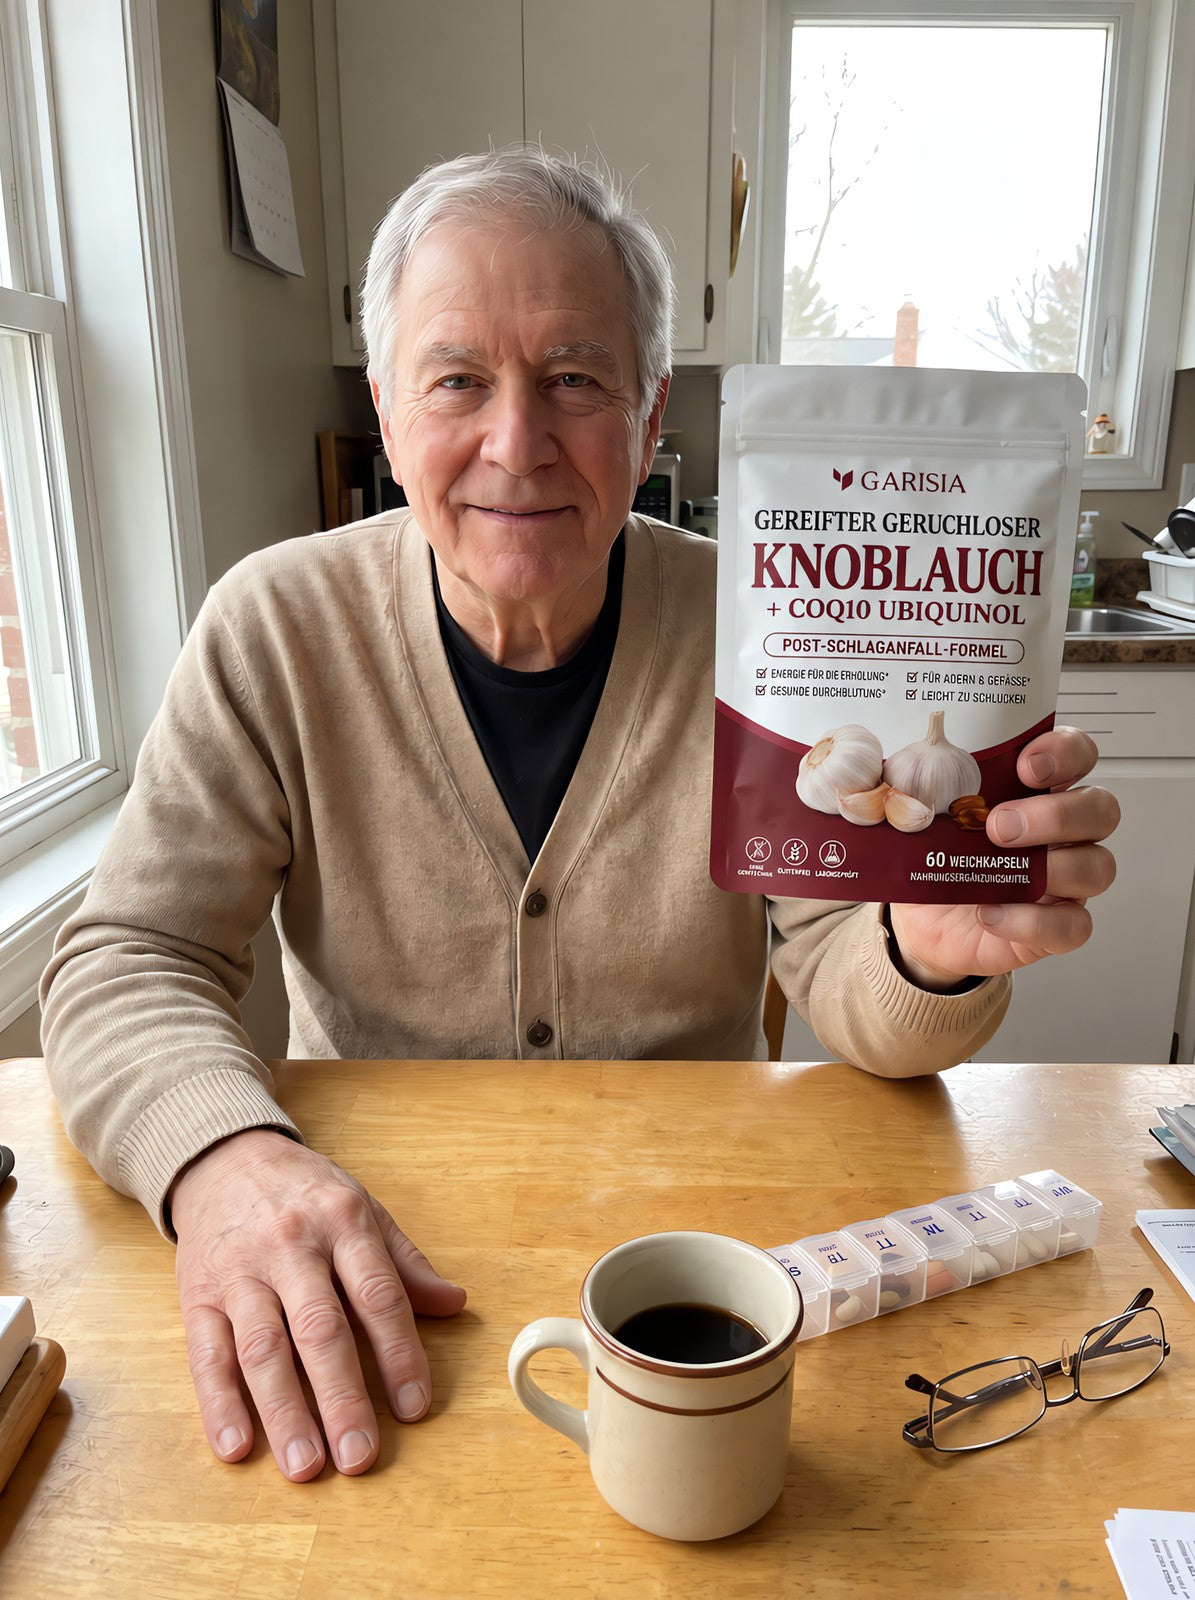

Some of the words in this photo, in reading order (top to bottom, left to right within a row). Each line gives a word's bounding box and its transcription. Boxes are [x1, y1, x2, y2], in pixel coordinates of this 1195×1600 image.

[861, 471, 966, 493] GARISIA
[754, 509, 877, 532] GEREIFTER
[882, 512, 1041, 538] GERUCHLOSER
[751, 543, 1044, 596] KNOBLAUCH
[767, 602, 781, 617] +
[788, 598, 871, 623] COQ10
[879, 600, 1026, 626] UBIQUINOL
[783, 638, 1008, 658] POST-SCHLAGANFALL-FORMEL
[771, 668, 806, 679] ENERGIE
[807, 668, 824, 680] FÜR
[826, 670, 839, 680] DIE
[922, 671, 940, 683] FÜR
[943, 674, 976, 685] ADERN
[770, 685, 810, 697] GESUNDE
[922, 690, 955, 701] LEICHT
[957, 691, 970, 702] ZU
[972, 693, 1026, 704] SCHLUCKEN
[926, 851, 946, 868] 60
[949, 855, 1030, 869] WEICHKAPSELN
